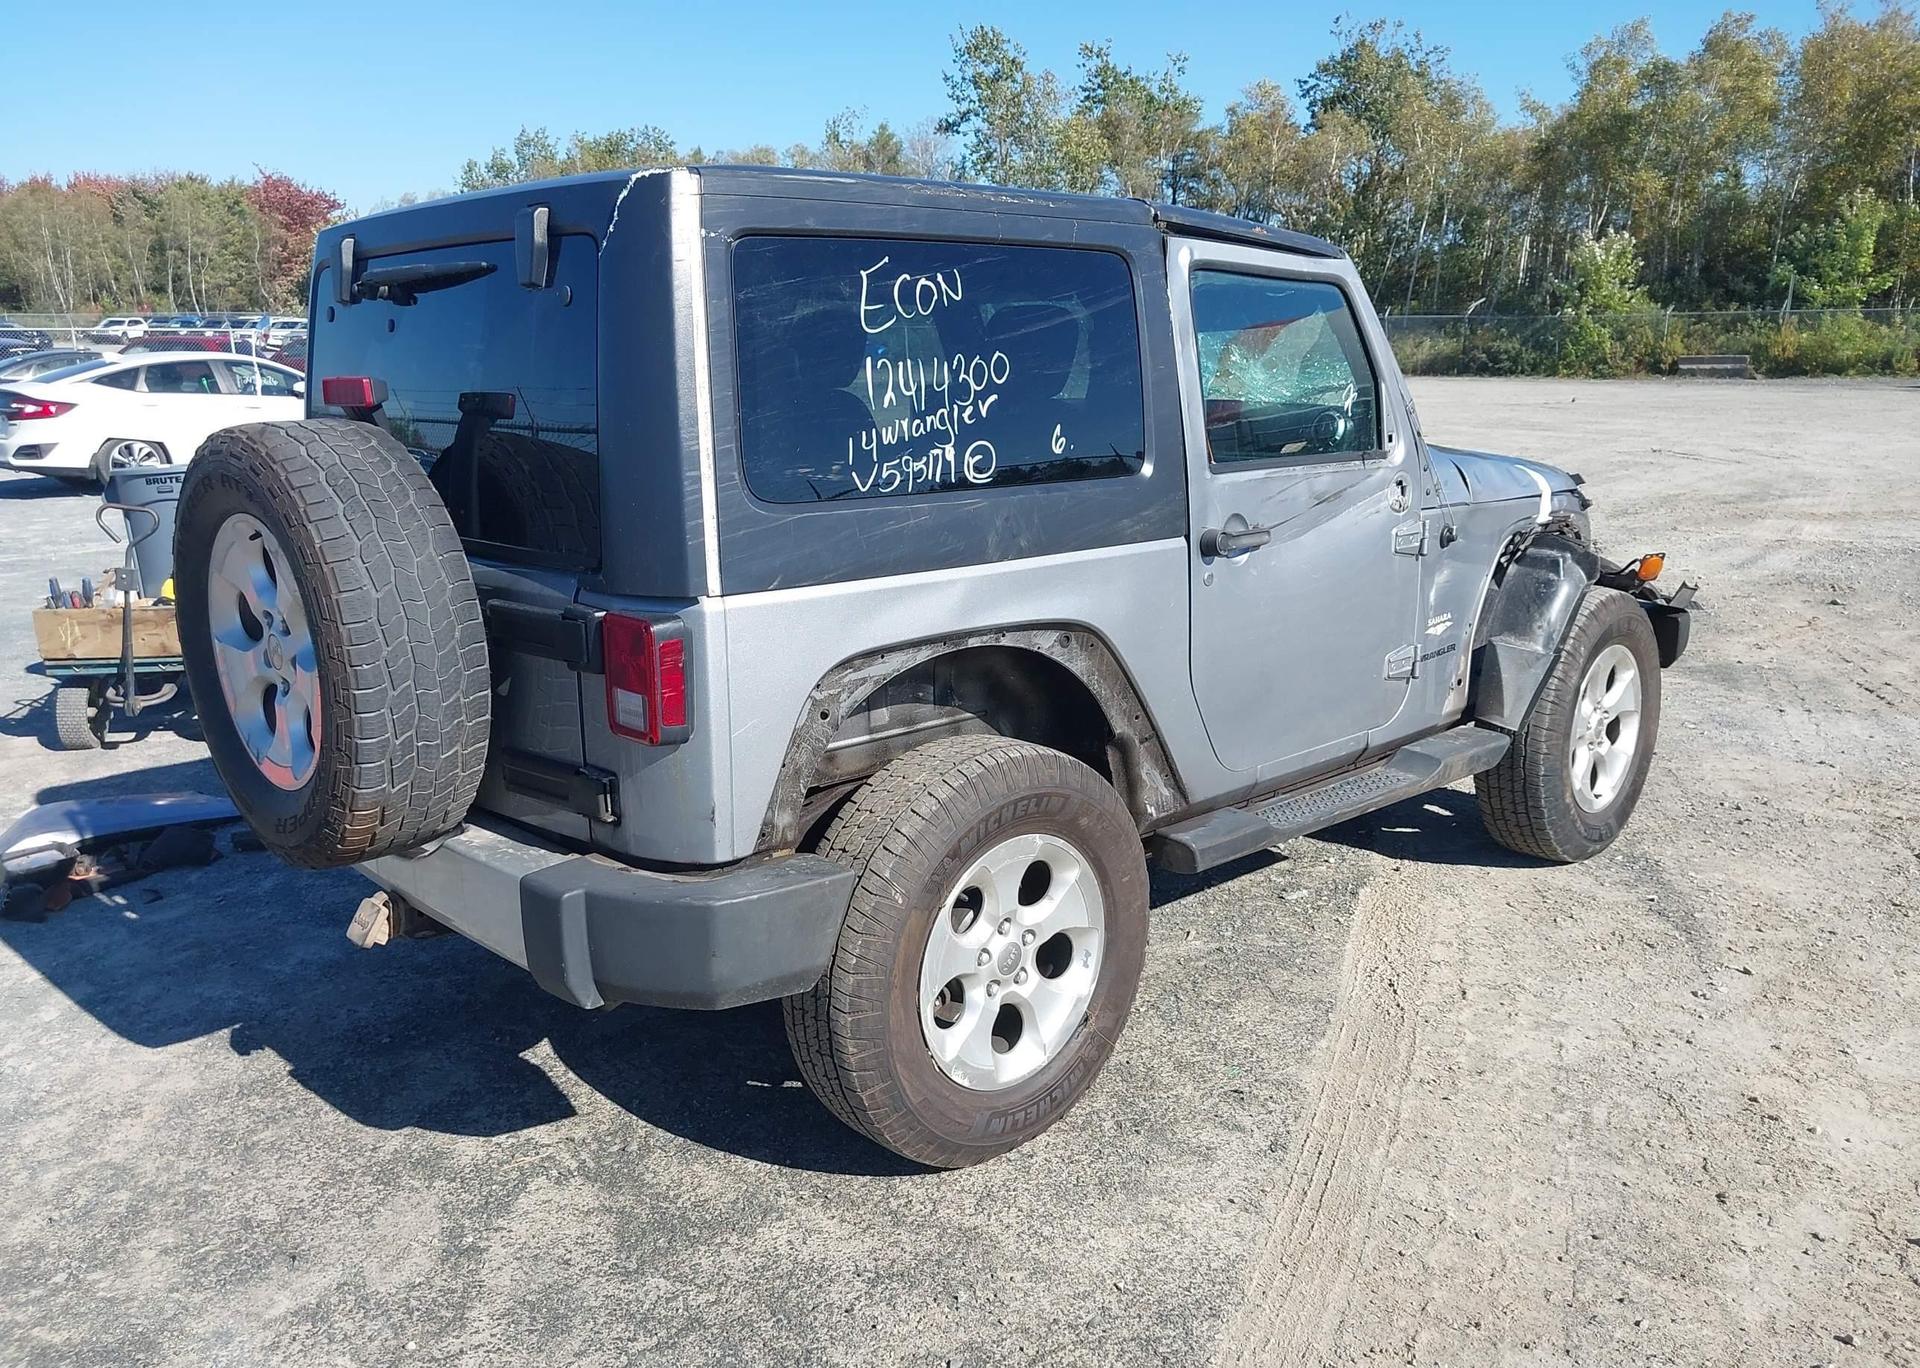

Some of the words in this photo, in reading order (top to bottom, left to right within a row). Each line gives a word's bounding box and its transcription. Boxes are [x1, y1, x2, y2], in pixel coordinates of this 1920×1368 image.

[860, 256, 962, 333] ECON
[865, 350, 1010, 412] 12414300
[145, 475, 184, 486] BRUTE
[959, 795, 1065, 855] MICHELIN
[989, 1060, 1086, 1134] MICHELIN
